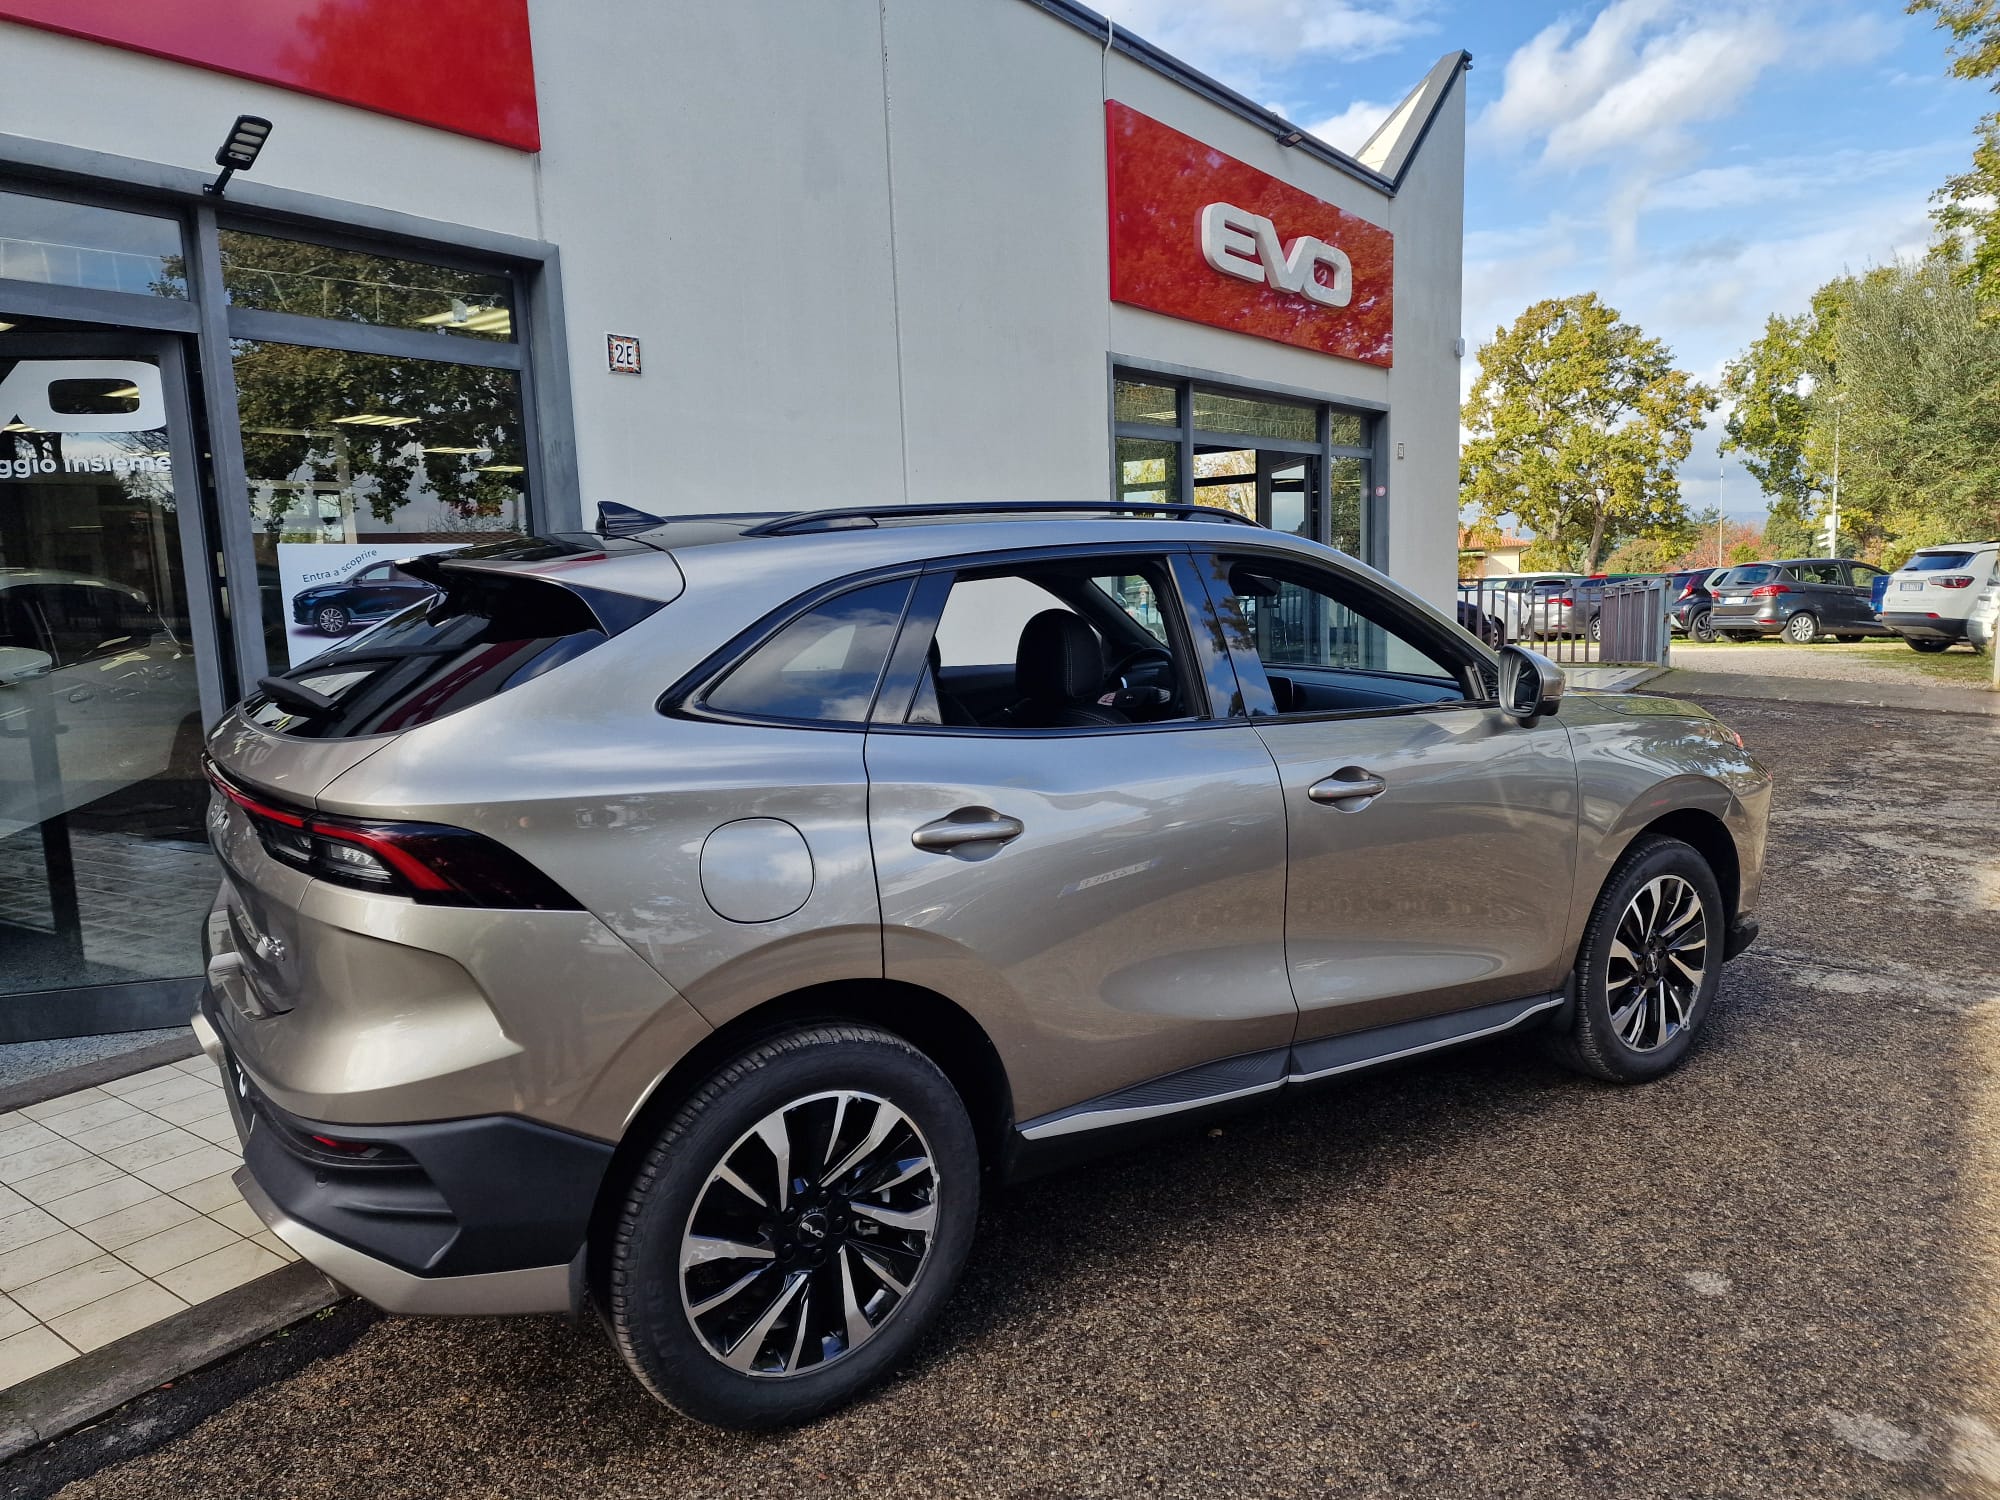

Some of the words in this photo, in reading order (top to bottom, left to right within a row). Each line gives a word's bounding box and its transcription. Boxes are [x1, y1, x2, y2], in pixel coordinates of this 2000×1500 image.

[1200, 201, 1353, 308] EVO
[615, 343, 634, 365] 2E
[63, 454, 172, 473] insieme
[302, 571, 331, 583] Entra
[333, 569, 340, 577] a
[341, 549, 377, 572] scoprire
[801, 1222, 824, 1238] EVO
